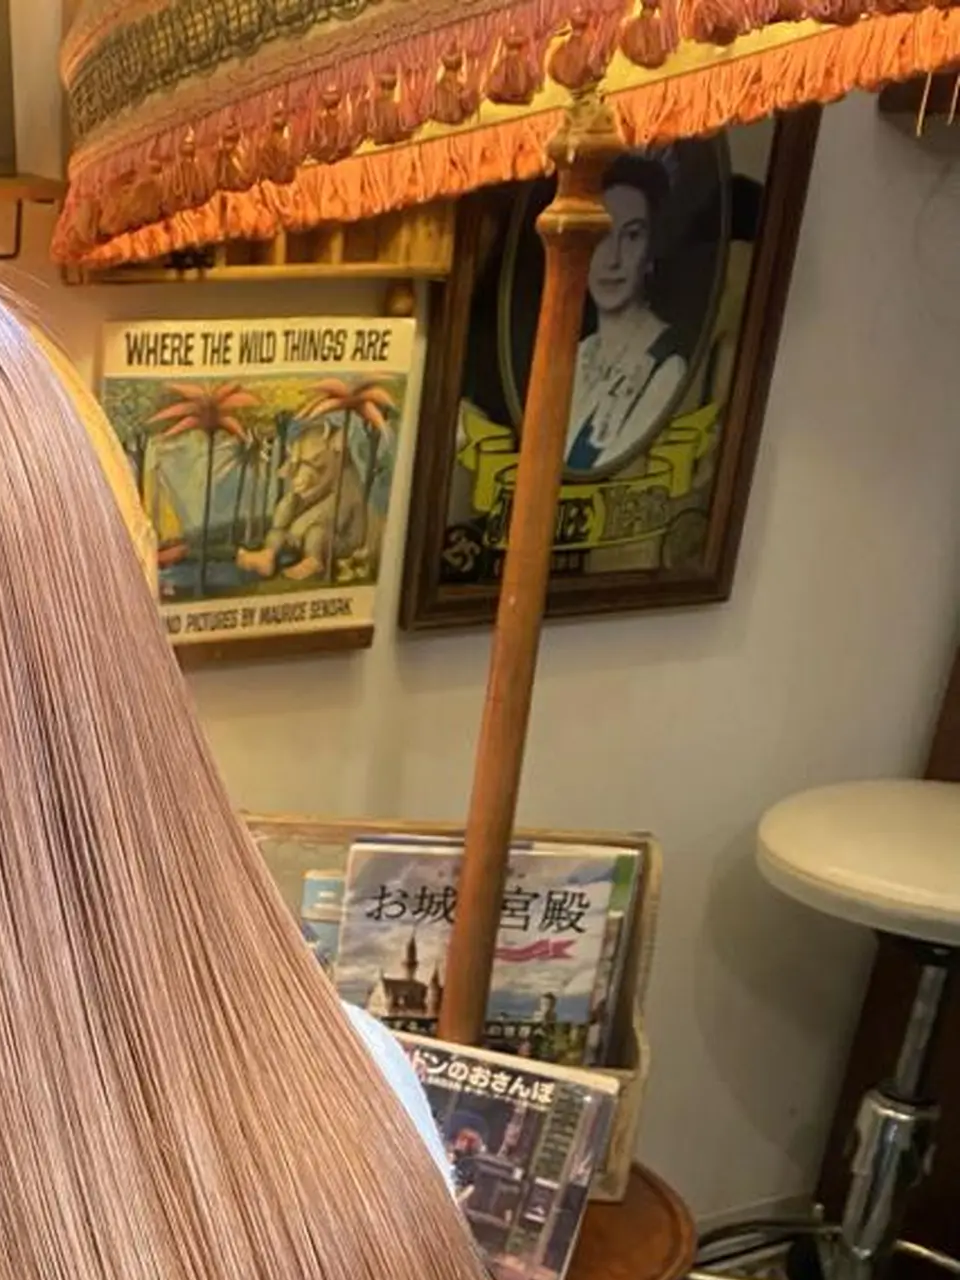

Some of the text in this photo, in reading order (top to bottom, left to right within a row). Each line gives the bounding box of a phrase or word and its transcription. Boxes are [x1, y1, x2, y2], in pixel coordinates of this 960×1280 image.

[125, 328, 392, 366] WHERE THE WILD THINGS ARE
[186, 609, 238, 633] PICTURES
[240, 606, 256, 628] BY
[258, 601, 307, 626] MAURICE
[366, 885, 590, 934] お城宮殿
